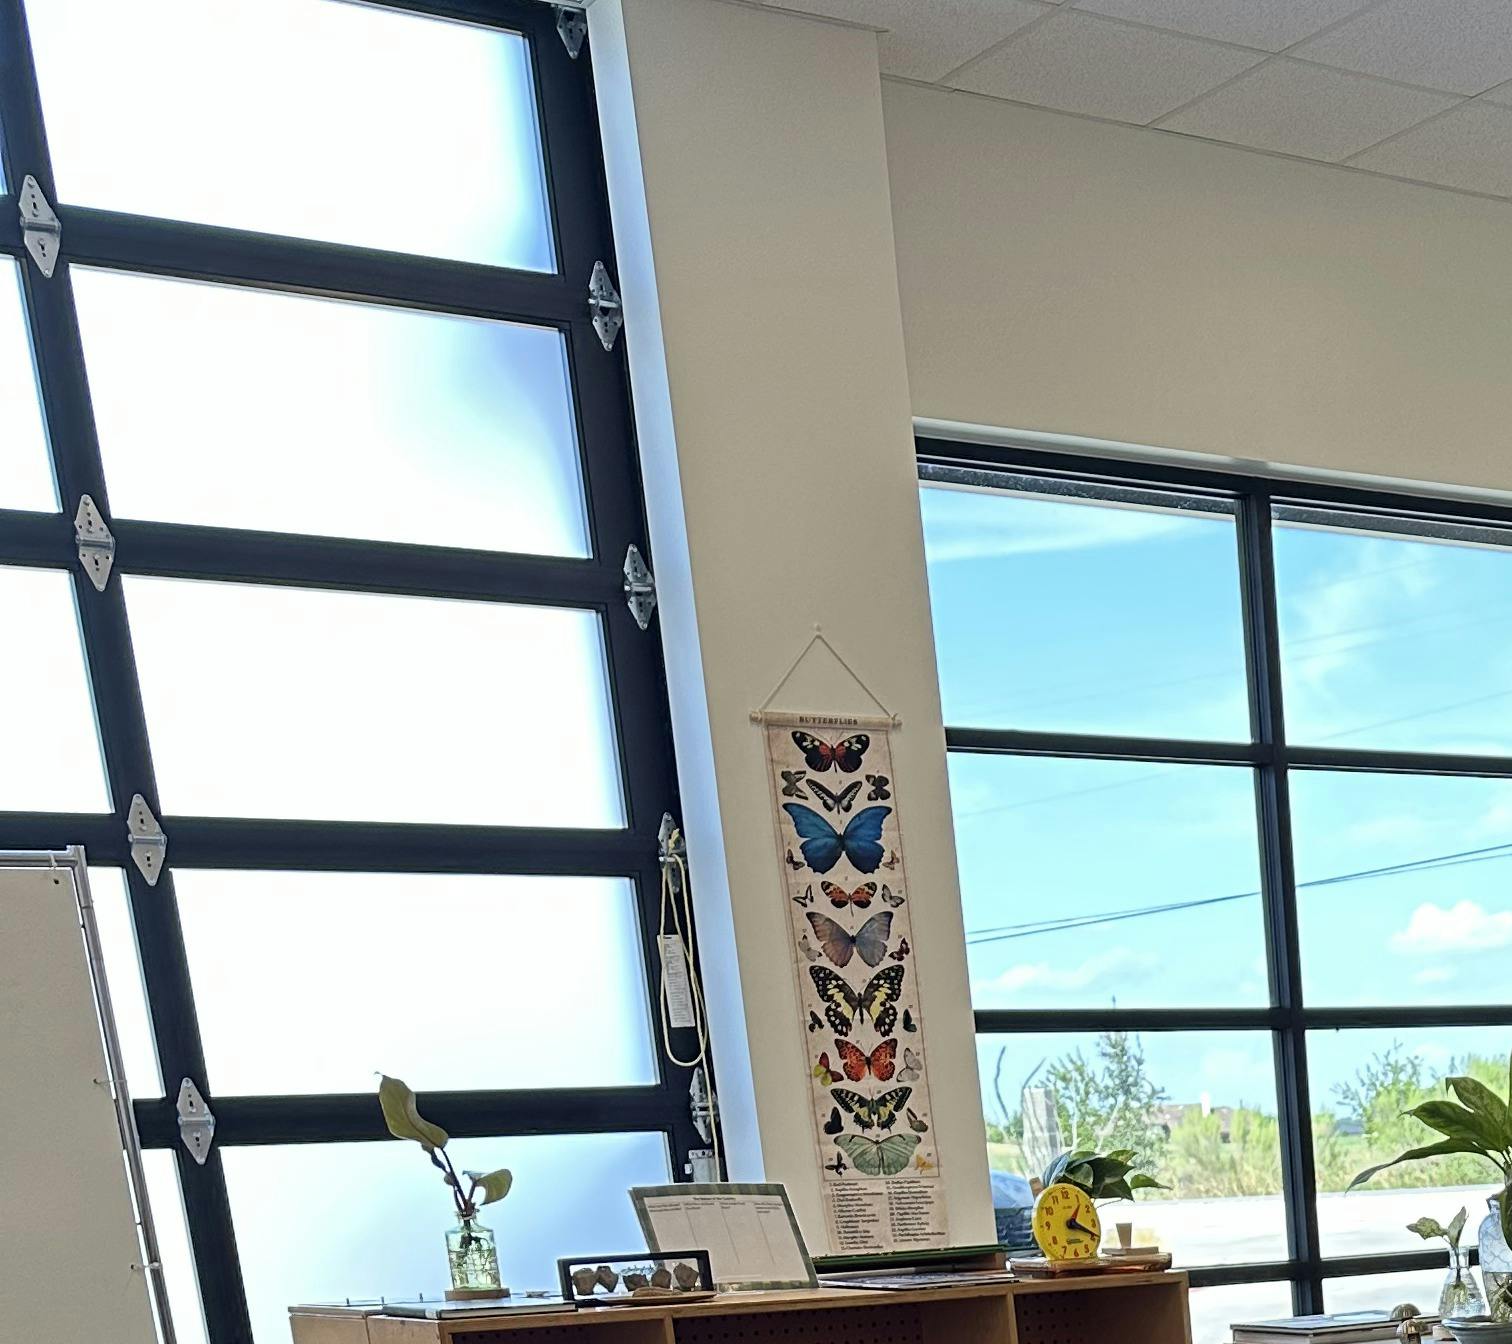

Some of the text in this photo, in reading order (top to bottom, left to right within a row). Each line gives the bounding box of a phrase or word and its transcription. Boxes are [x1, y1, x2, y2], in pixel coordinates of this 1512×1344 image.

[799, 716, 858, 725] BUTTERFLIES
[1060, 1190, 1070, 1199] 12
[1051, 1195, 1059, 1205] 11
[1045, 1206, 1054, 1216] 10
[1085, 1204, 1090, 1214] 2
[1045, 1221, 1051, 1230] 9
[1061, 1245, 1067, 1255] 7
[1073, 1248, 1079, 1257] 6
